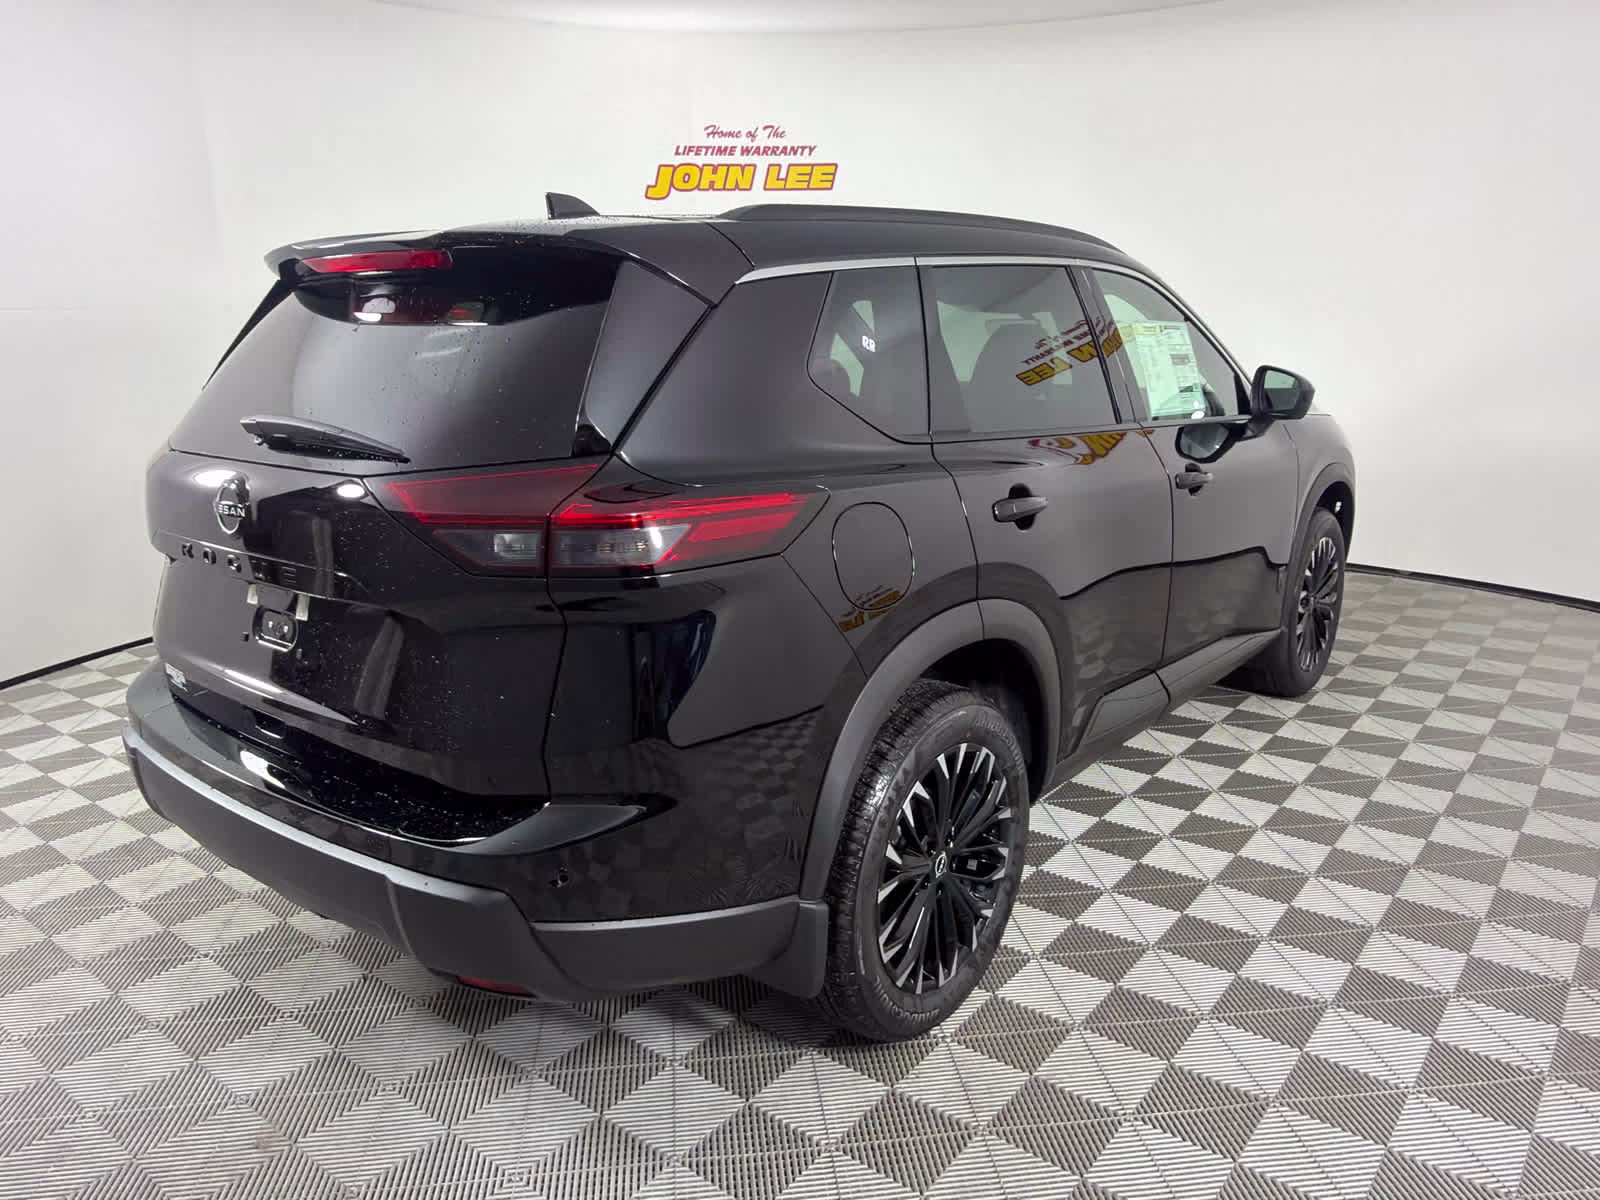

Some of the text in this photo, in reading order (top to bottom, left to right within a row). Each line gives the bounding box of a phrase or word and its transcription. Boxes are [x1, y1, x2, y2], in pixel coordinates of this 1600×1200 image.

[703, 124, 786, 143] Home of The
[674, 145, 817, 157] LIFETIME WARRANTY
[645, 163, 838, 200] JOHN LEE
